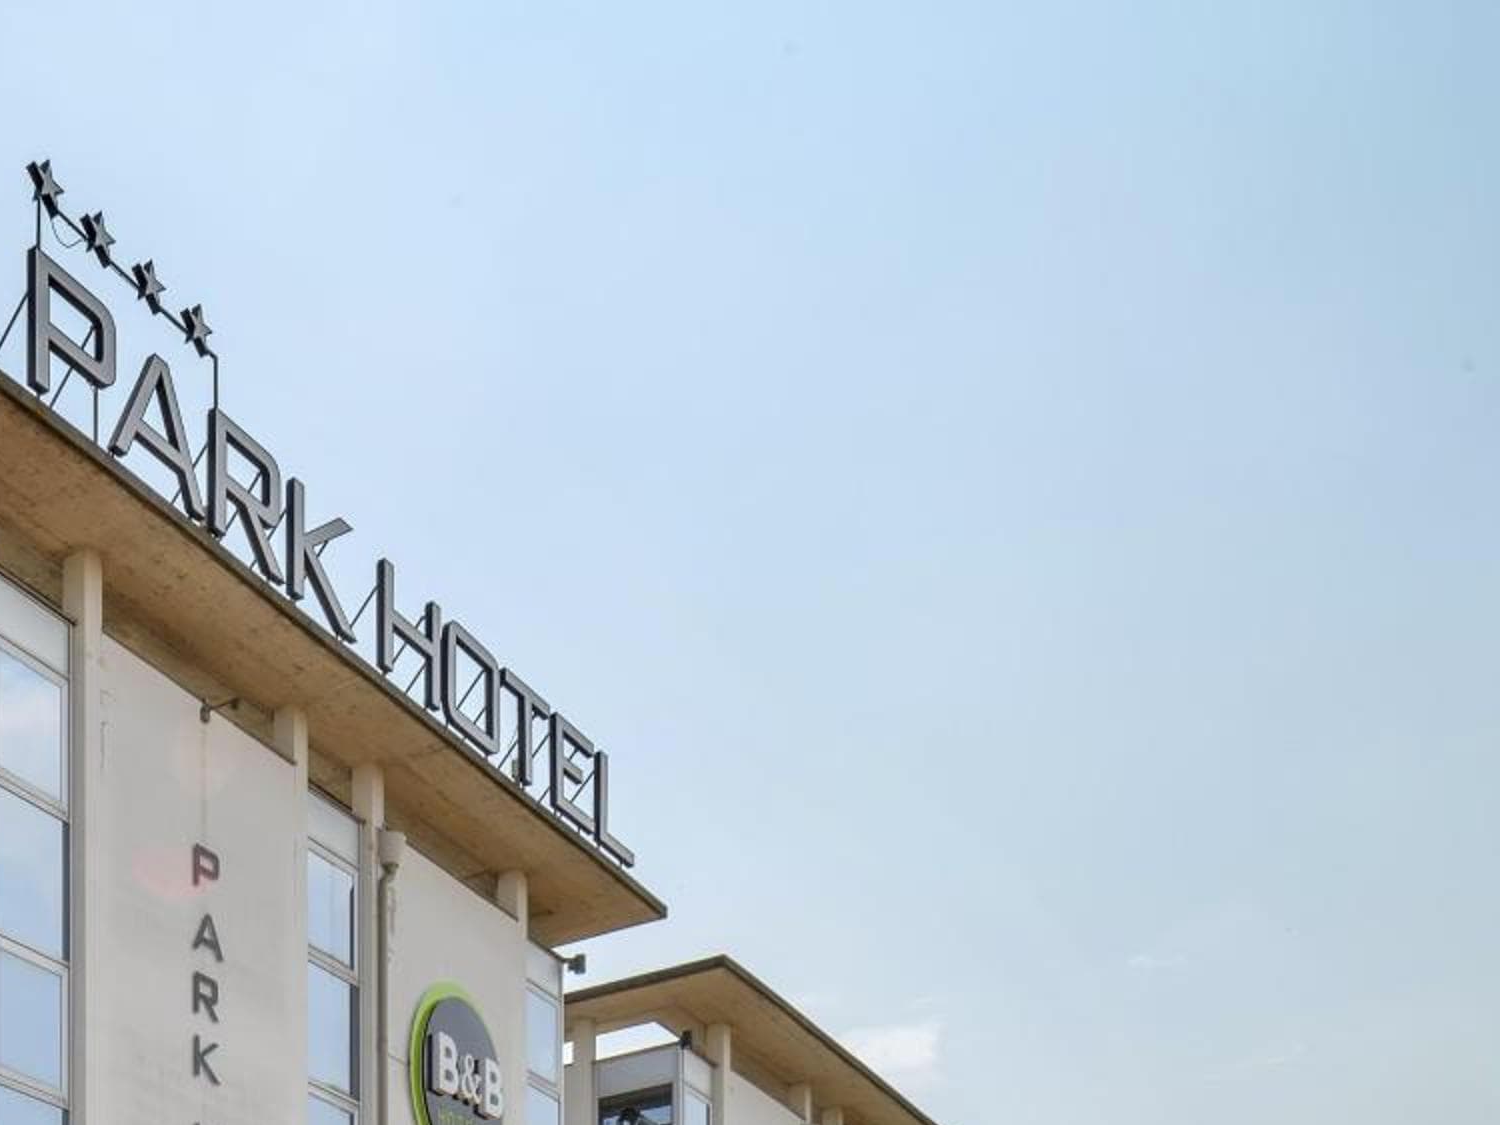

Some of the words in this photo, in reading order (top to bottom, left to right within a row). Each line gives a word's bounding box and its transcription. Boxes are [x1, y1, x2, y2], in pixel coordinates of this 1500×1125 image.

[27, 245, 357, 645] PARK
[376, 557, 635, 868] HOTEL
[191, 843, 225, 1087] PARK
[431, 1031, 504, 1120] B&B
